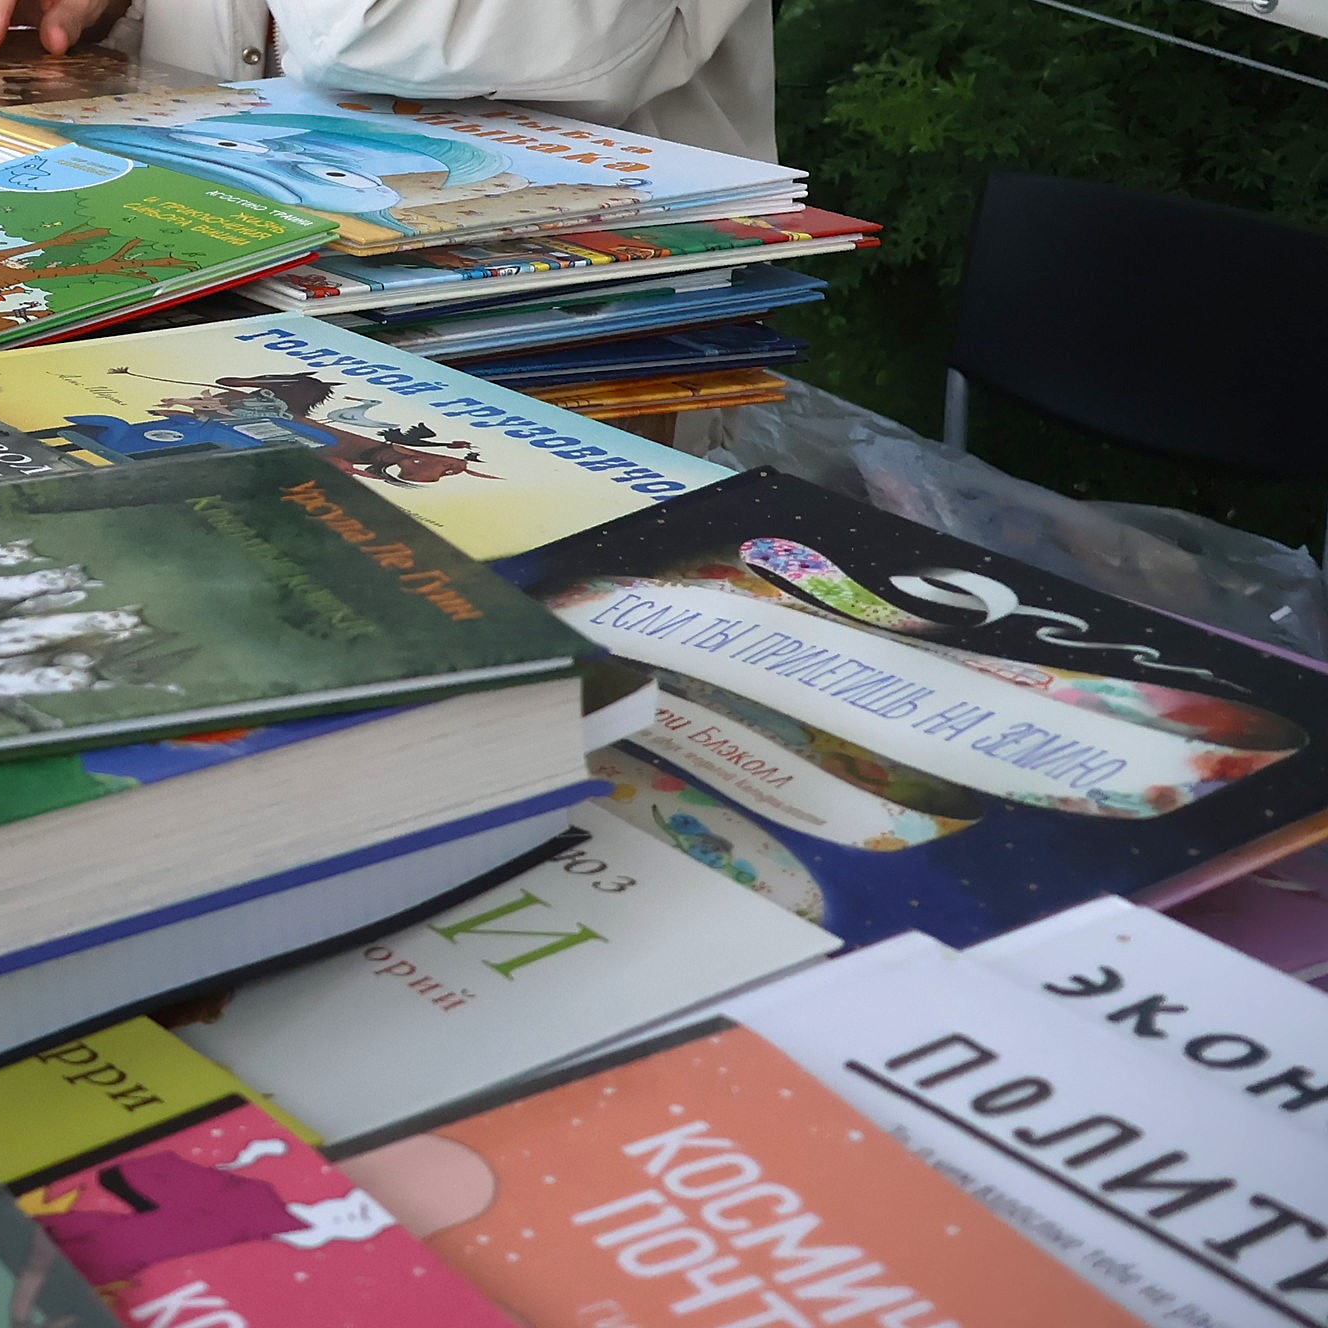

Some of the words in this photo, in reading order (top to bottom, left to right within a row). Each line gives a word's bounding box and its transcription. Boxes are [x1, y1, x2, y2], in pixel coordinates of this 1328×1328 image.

[159, 200, 273, 241] ПРИКЛЮЧЕНИЯ
[206, 189, 269, 212] АГОСТИНО
[231, 211, 288, 234] ЖИЗНЬ
[232, 327, 451, 397] ГОЛУБОЙ
[590, 591, 691, 645] ЕСЛИ
[742, 625, 928, 723] ПРИЛЕТИШЬ
[917, 699, 979, 742] НА
[572, 1188, 816, 1328] ПОЧТ
